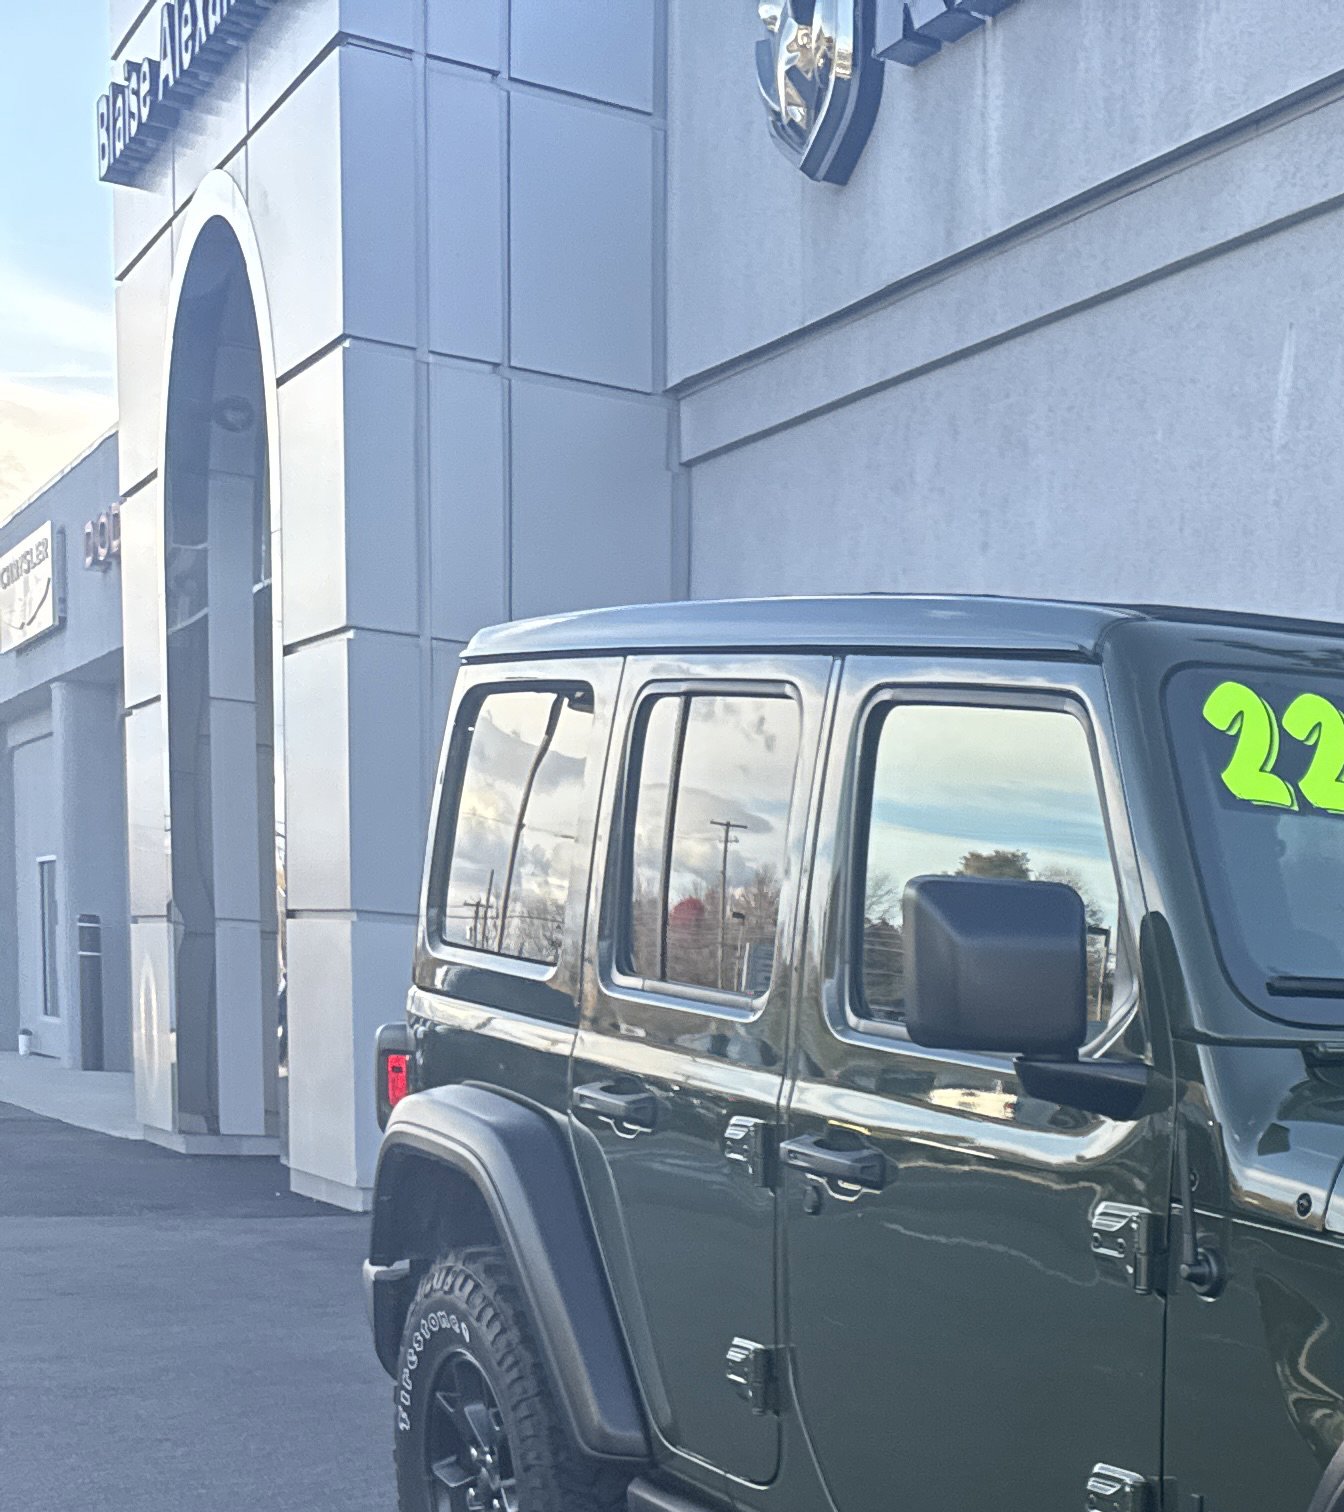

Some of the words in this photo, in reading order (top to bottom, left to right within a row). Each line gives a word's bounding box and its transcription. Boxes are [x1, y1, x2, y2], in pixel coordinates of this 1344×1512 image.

[97, 57, 151, 180] Blaise
[0, 537, 49, 590] CHRYSLER
[398, 1310, 461, 1431] Firestone
